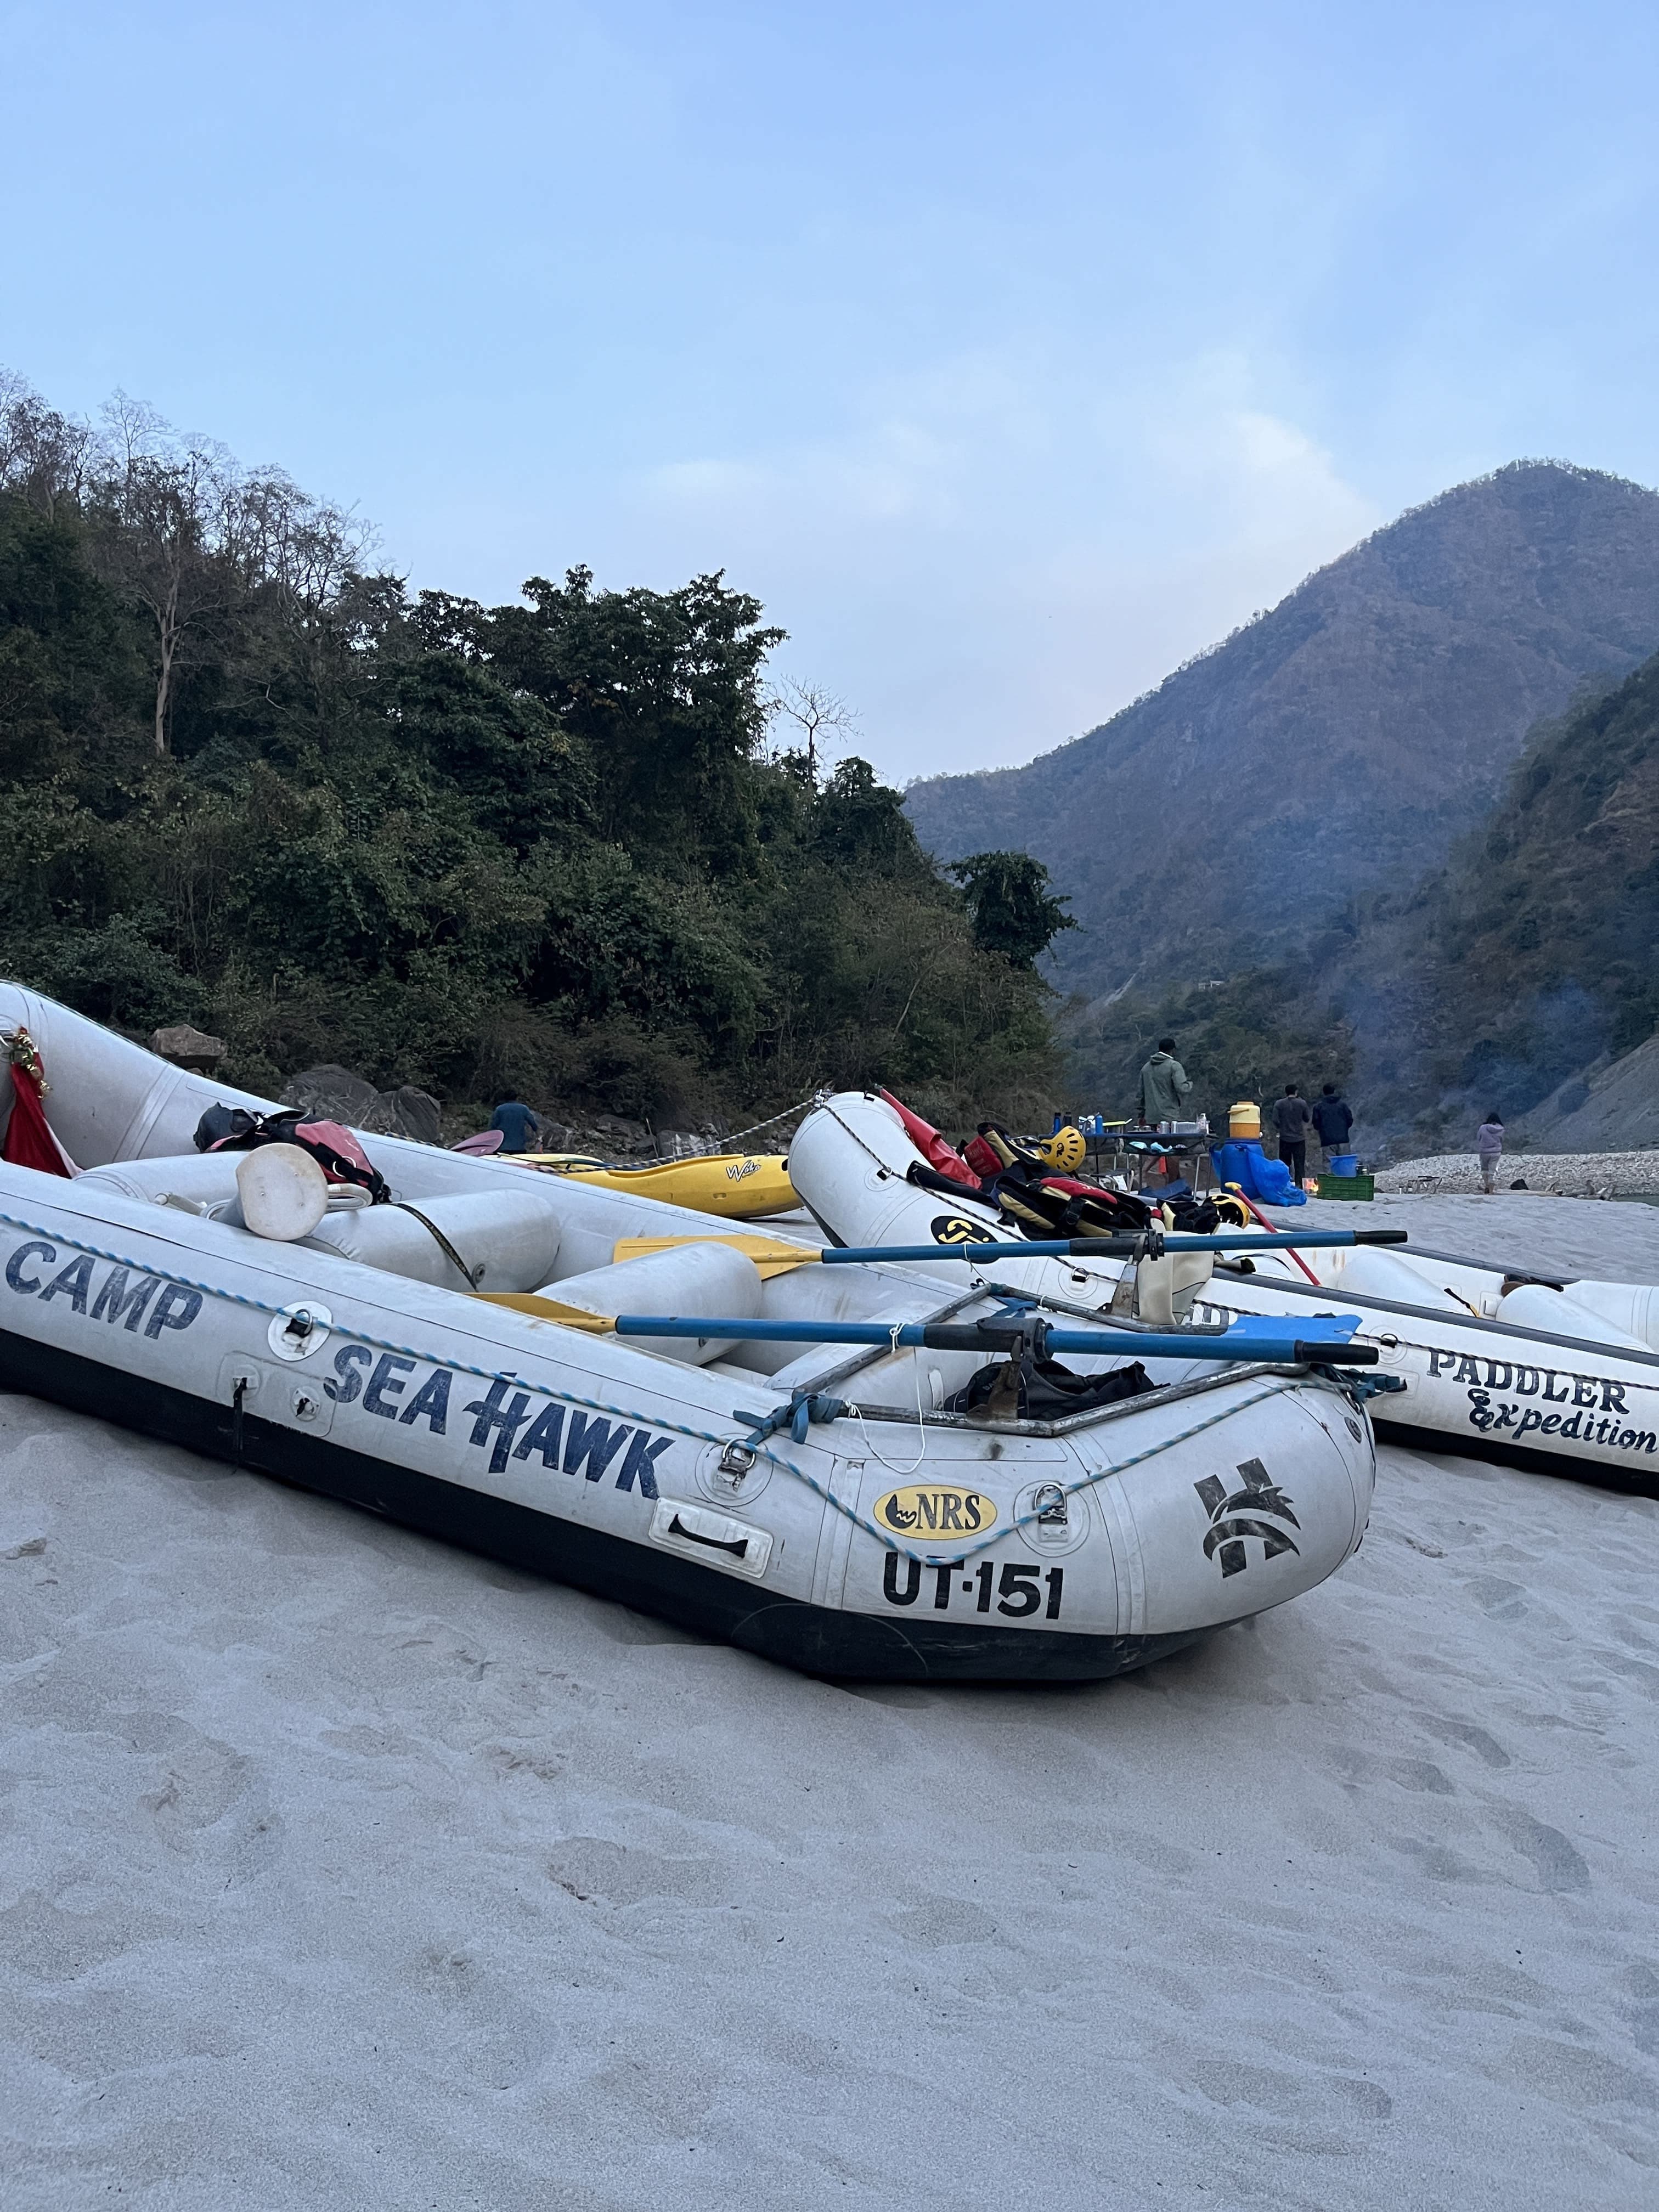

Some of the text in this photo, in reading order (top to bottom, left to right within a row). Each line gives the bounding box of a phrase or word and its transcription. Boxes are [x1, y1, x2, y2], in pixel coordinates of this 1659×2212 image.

[5, 1242, 676, 1500] CAMP SEA HAWK
[1426, 1350, 1630, 1415] PADDLER
[1467, 1388, 1658, 1454] Expedition
[915, 1493, 981, 1530] NRS
